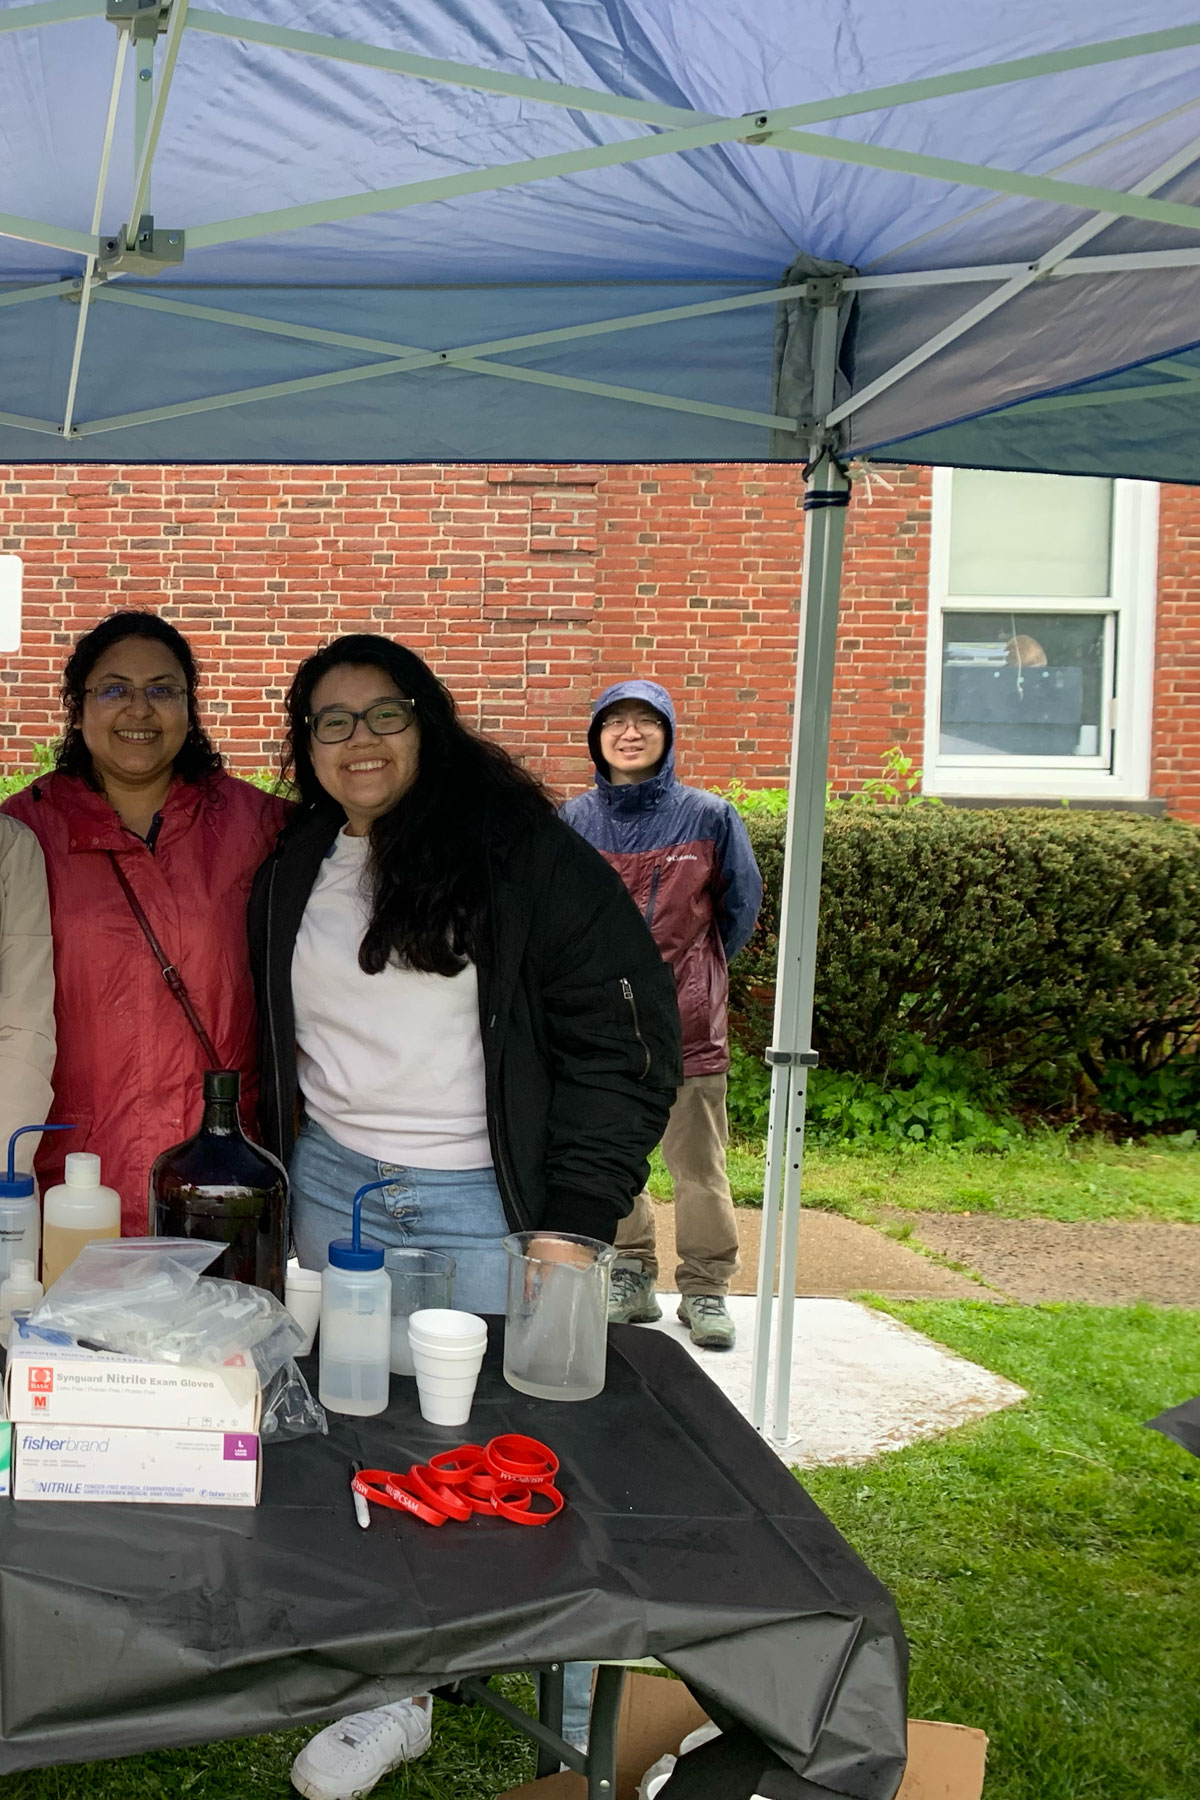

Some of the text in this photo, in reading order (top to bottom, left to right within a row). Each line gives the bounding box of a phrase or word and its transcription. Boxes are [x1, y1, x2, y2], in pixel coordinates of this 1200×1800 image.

[56, 1373, 214, 1389] Synguard Nitrile Exam Gloves
[34, 1396, 47, 1407] M
[22, 1436, 110, 1453] fisherbrand
[238, 1440, 244, 1448] L
[39, 1482, 82, 1494] NITRILE
